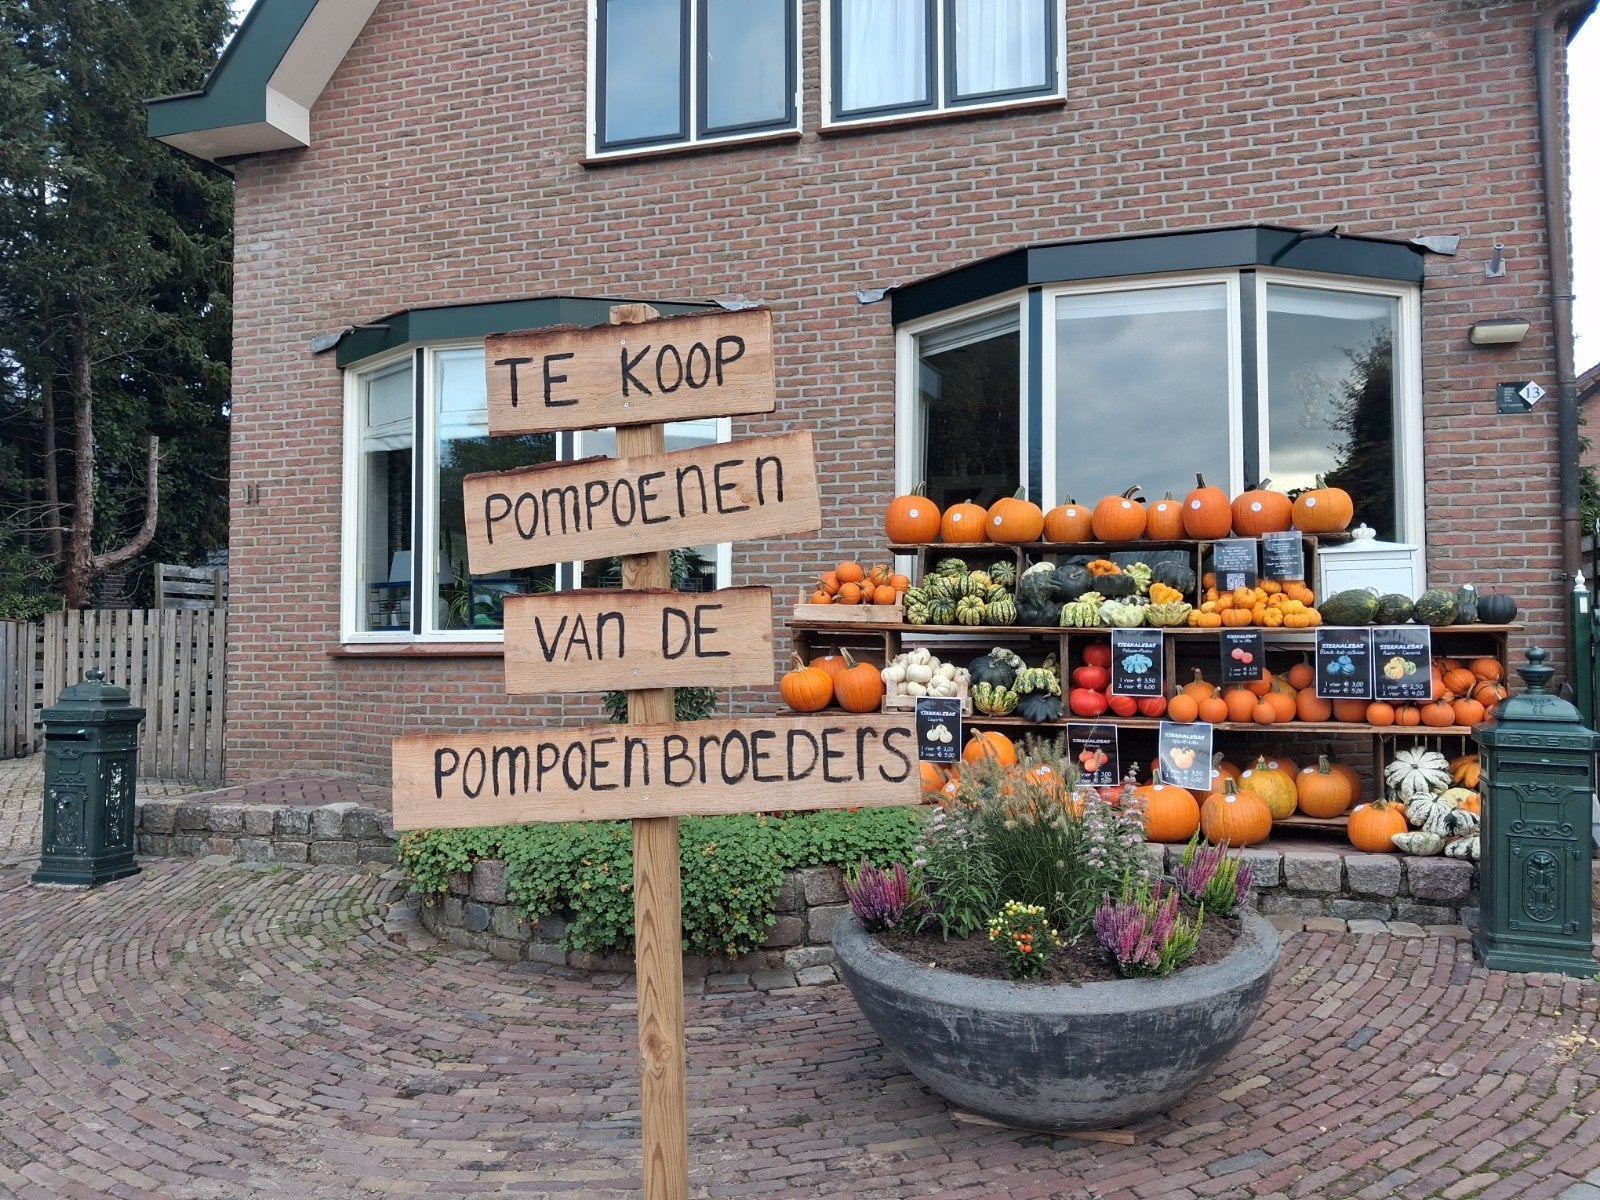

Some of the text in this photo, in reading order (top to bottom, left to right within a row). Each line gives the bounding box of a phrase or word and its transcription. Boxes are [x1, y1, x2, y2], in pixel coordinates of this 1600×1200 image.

[494, 335, 746, 408] TE KOOP
[1525, 387, 1541, 399] 13
[535, 603, 731, 664] VAN DE
